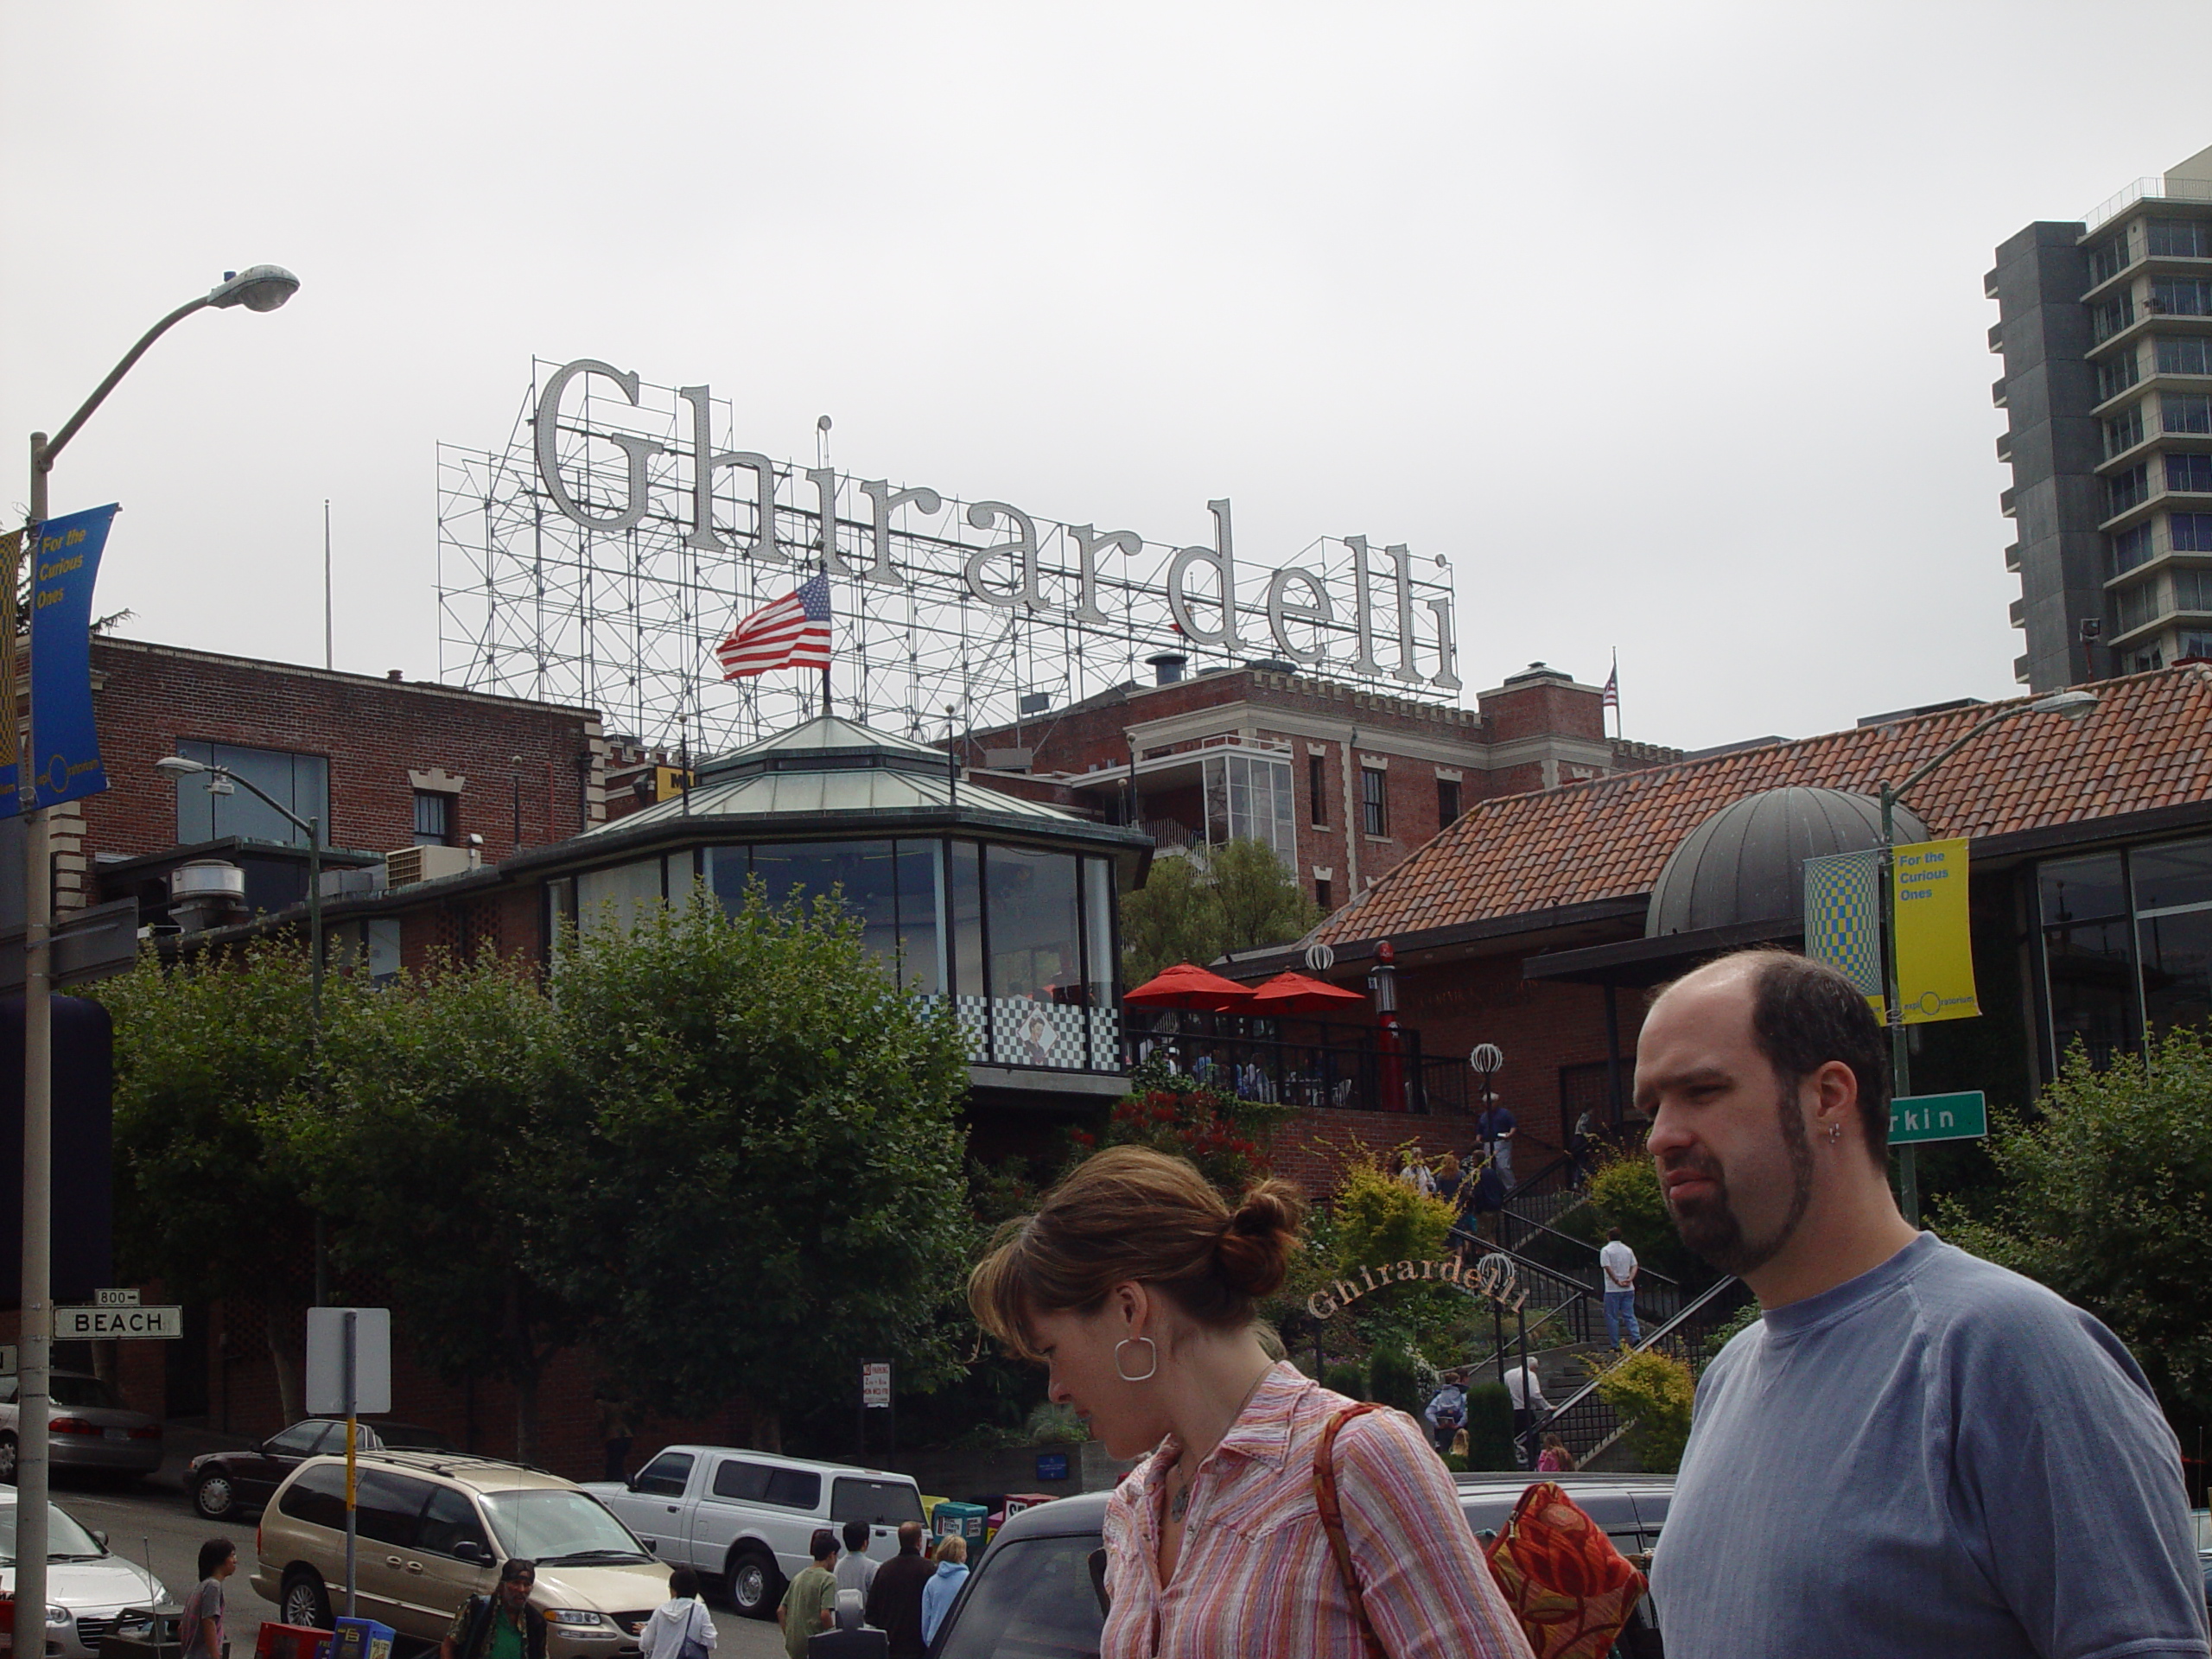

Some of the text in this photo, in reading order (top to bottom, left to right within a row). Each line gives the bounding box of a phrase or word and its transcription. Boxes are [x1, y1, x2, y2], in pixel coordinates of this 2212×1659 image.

[536, 358, 1463, 690] Ghirardelli
[41, 529, 86, 554] For the
[39, 555, 83, 581] Curious
[36, 588, 64, 609] Ones
[1899, 851, 1944, 867] For the
[1899, 868, 1948, 884] Curious
[1900, 888, 1932, 901] Ones
[1889, 1109, 1954, 1132] rkin
[1307, 1255, 1529, 1319] Ghirardelli
[101, 1293, 125, 1303] 800
[75, 1313, 162, 1332] BEACH
